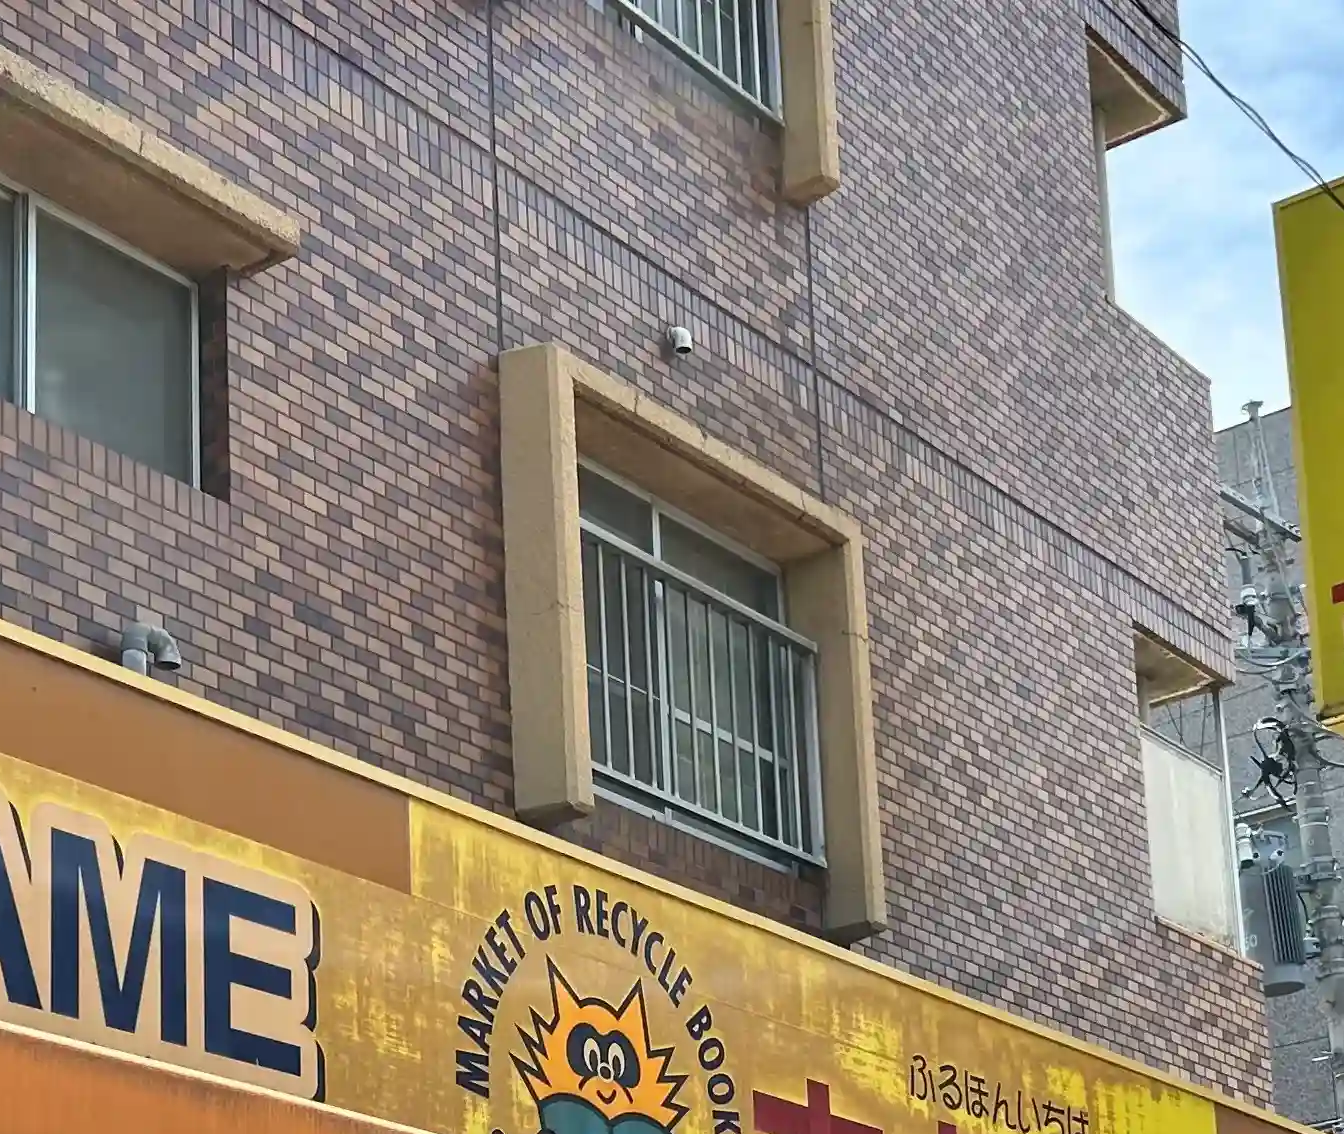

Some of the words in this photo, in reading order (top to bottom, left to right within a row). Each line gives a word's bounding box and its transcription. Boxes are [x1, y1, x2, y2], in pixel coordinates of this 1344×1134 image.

[455, 908, 526, 1099] MARKET
[524, 884, 562, 941] OF
[573, 884, 693, 1008] RECYCLE
